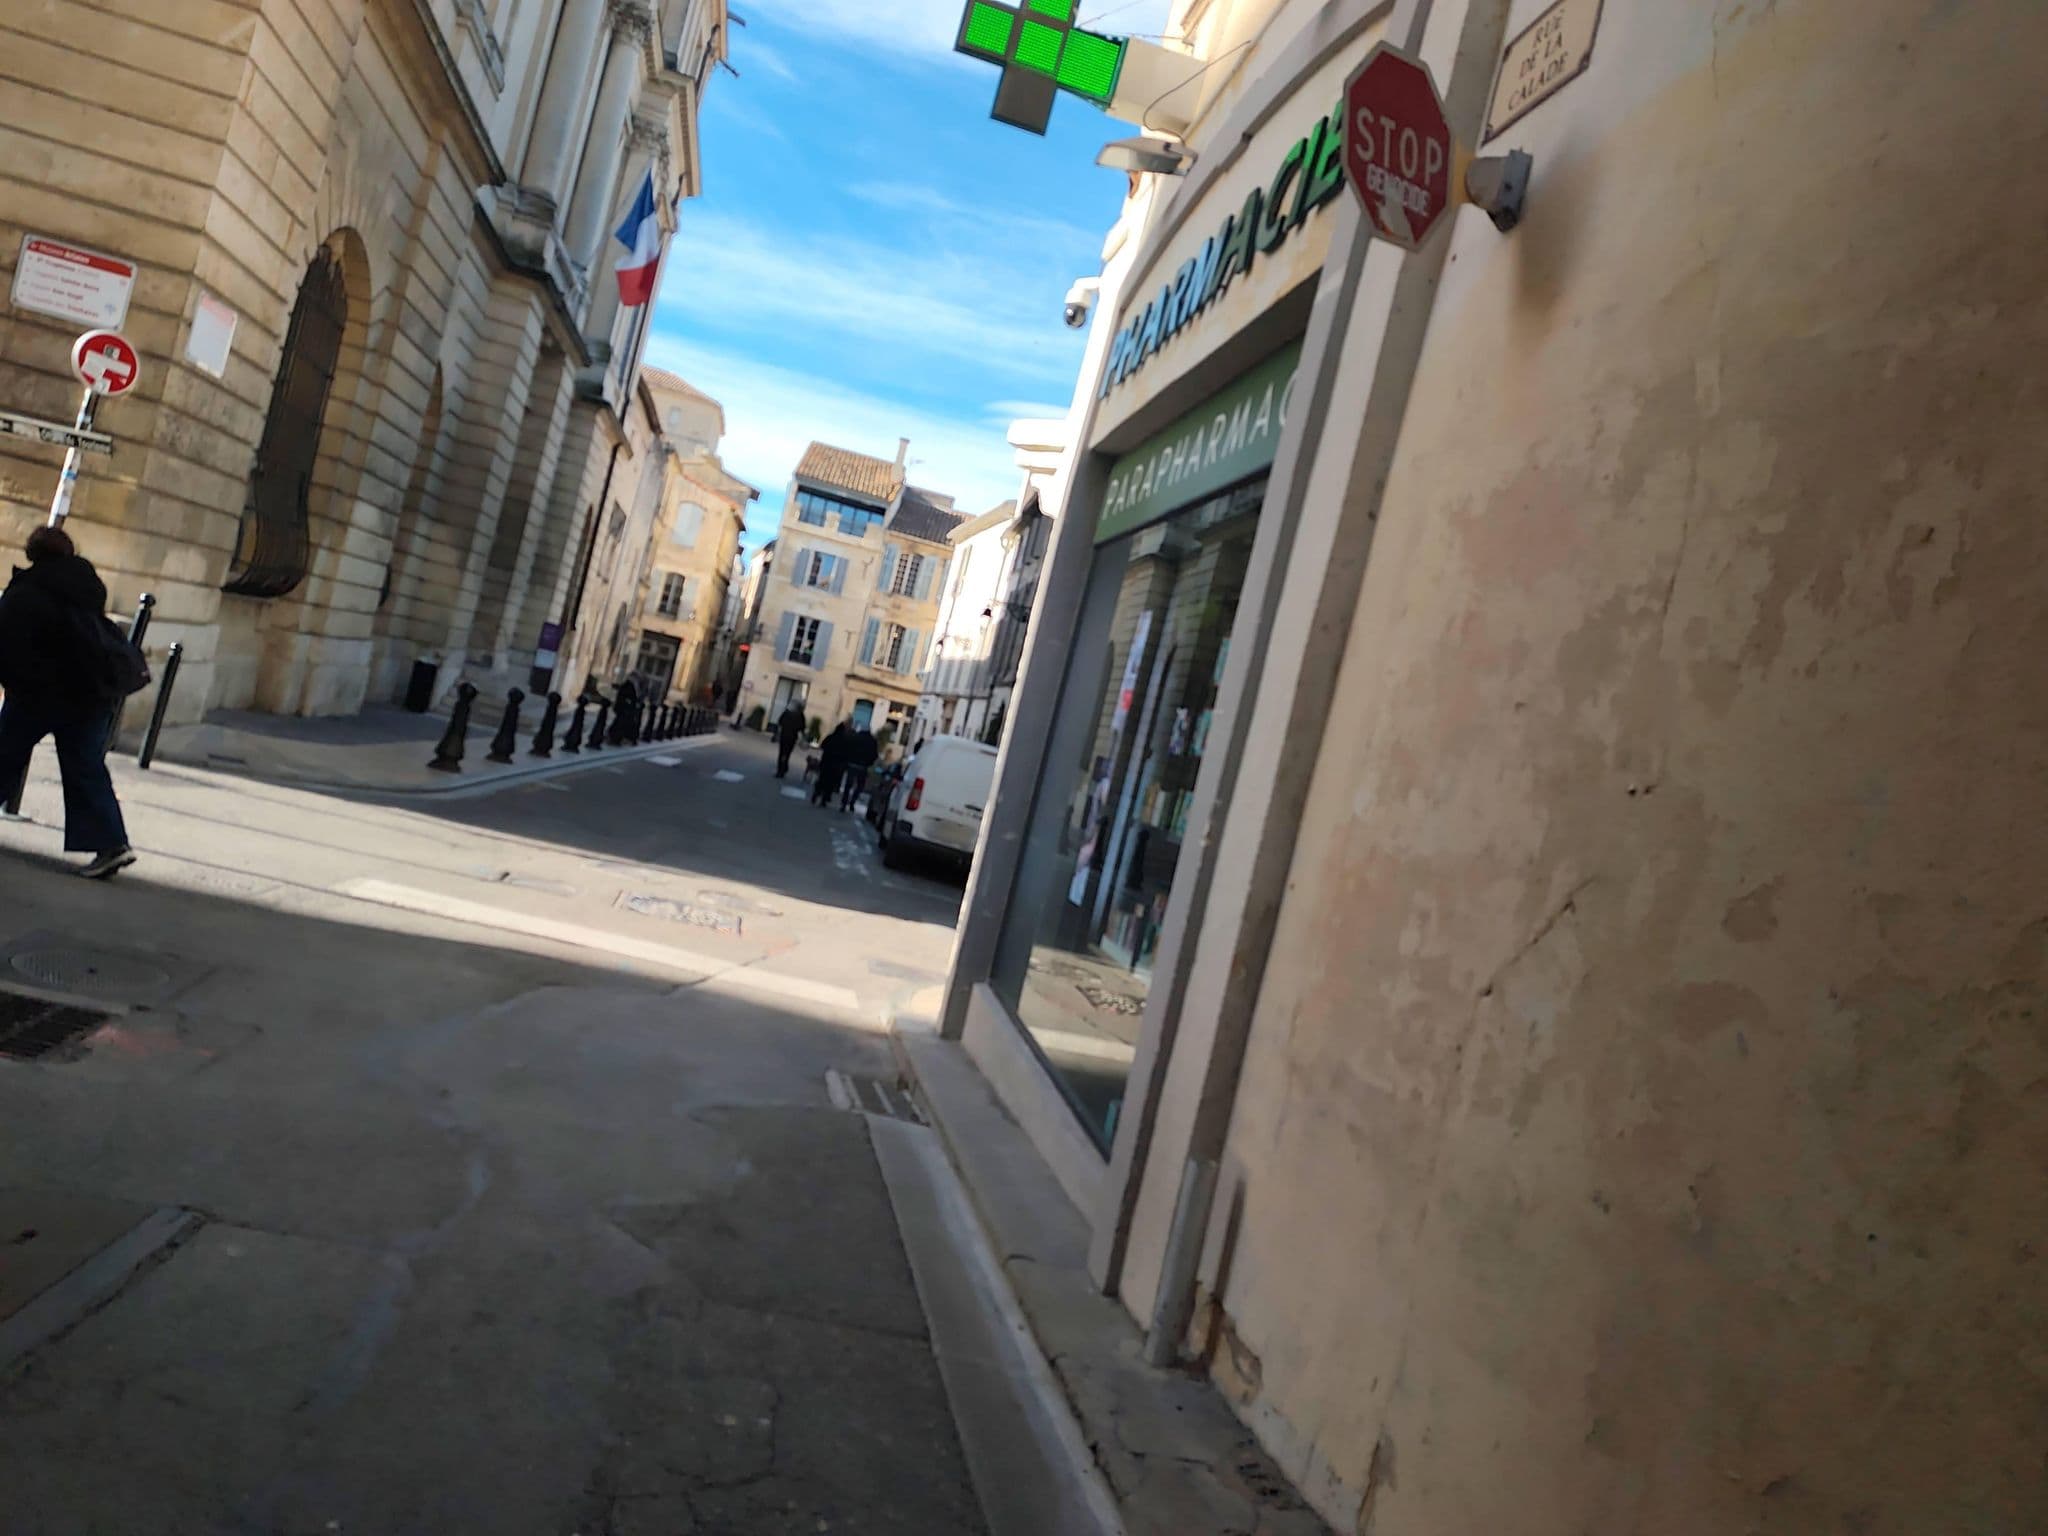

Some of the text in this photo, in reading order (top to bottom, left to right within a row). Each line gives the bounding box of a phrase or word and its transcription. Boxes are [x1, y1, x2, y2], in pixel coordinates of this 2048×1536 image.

[1507, 50, 1569, 111] CALADE
[1519, 49, 1540, 79] DE
[1355, 106, 1443, 189] STOP
